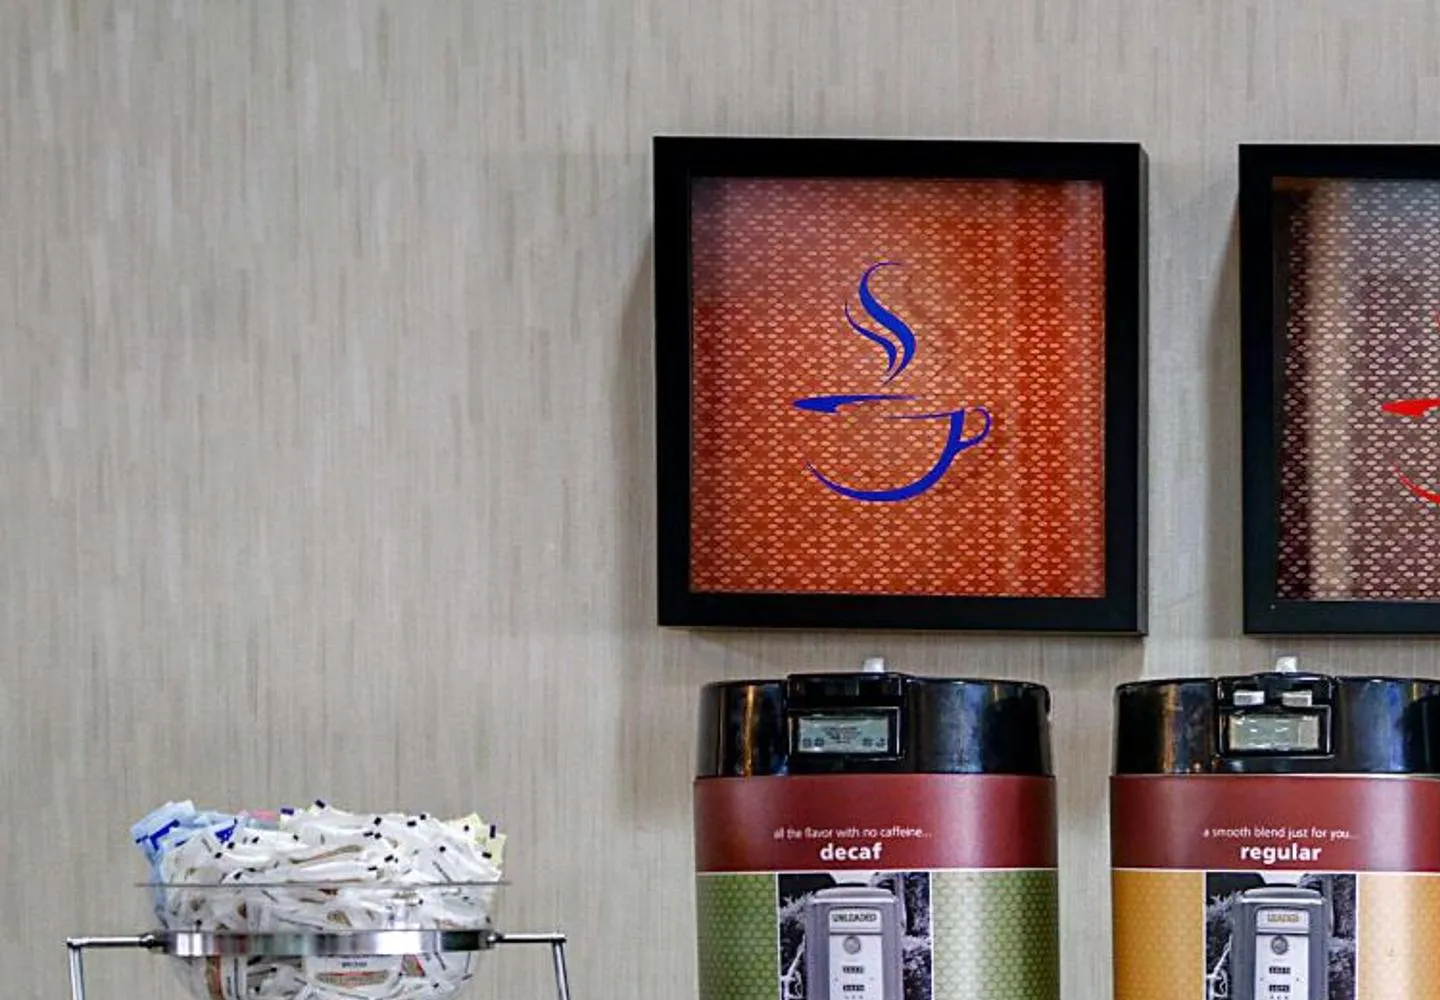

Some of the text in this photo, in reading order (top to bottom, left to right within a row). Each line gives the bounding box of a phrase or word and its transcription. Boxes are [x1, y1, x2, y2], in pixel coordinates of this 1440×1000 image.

[787, 826, 802, 839] the
[805, 826, 833, 839] flavor
[836, 826, 860, 838] with
[863, 828, 878, 838] no
[1212, 826, 1251, 838] smooth
[1254, 826, 1285, 838] blend
[1288, 826, 1309, 840] just
[1311, 827, 1327, 839] for
[820, 842, 882, 861] decaf
[1240, 842, 1322, 865] regular
